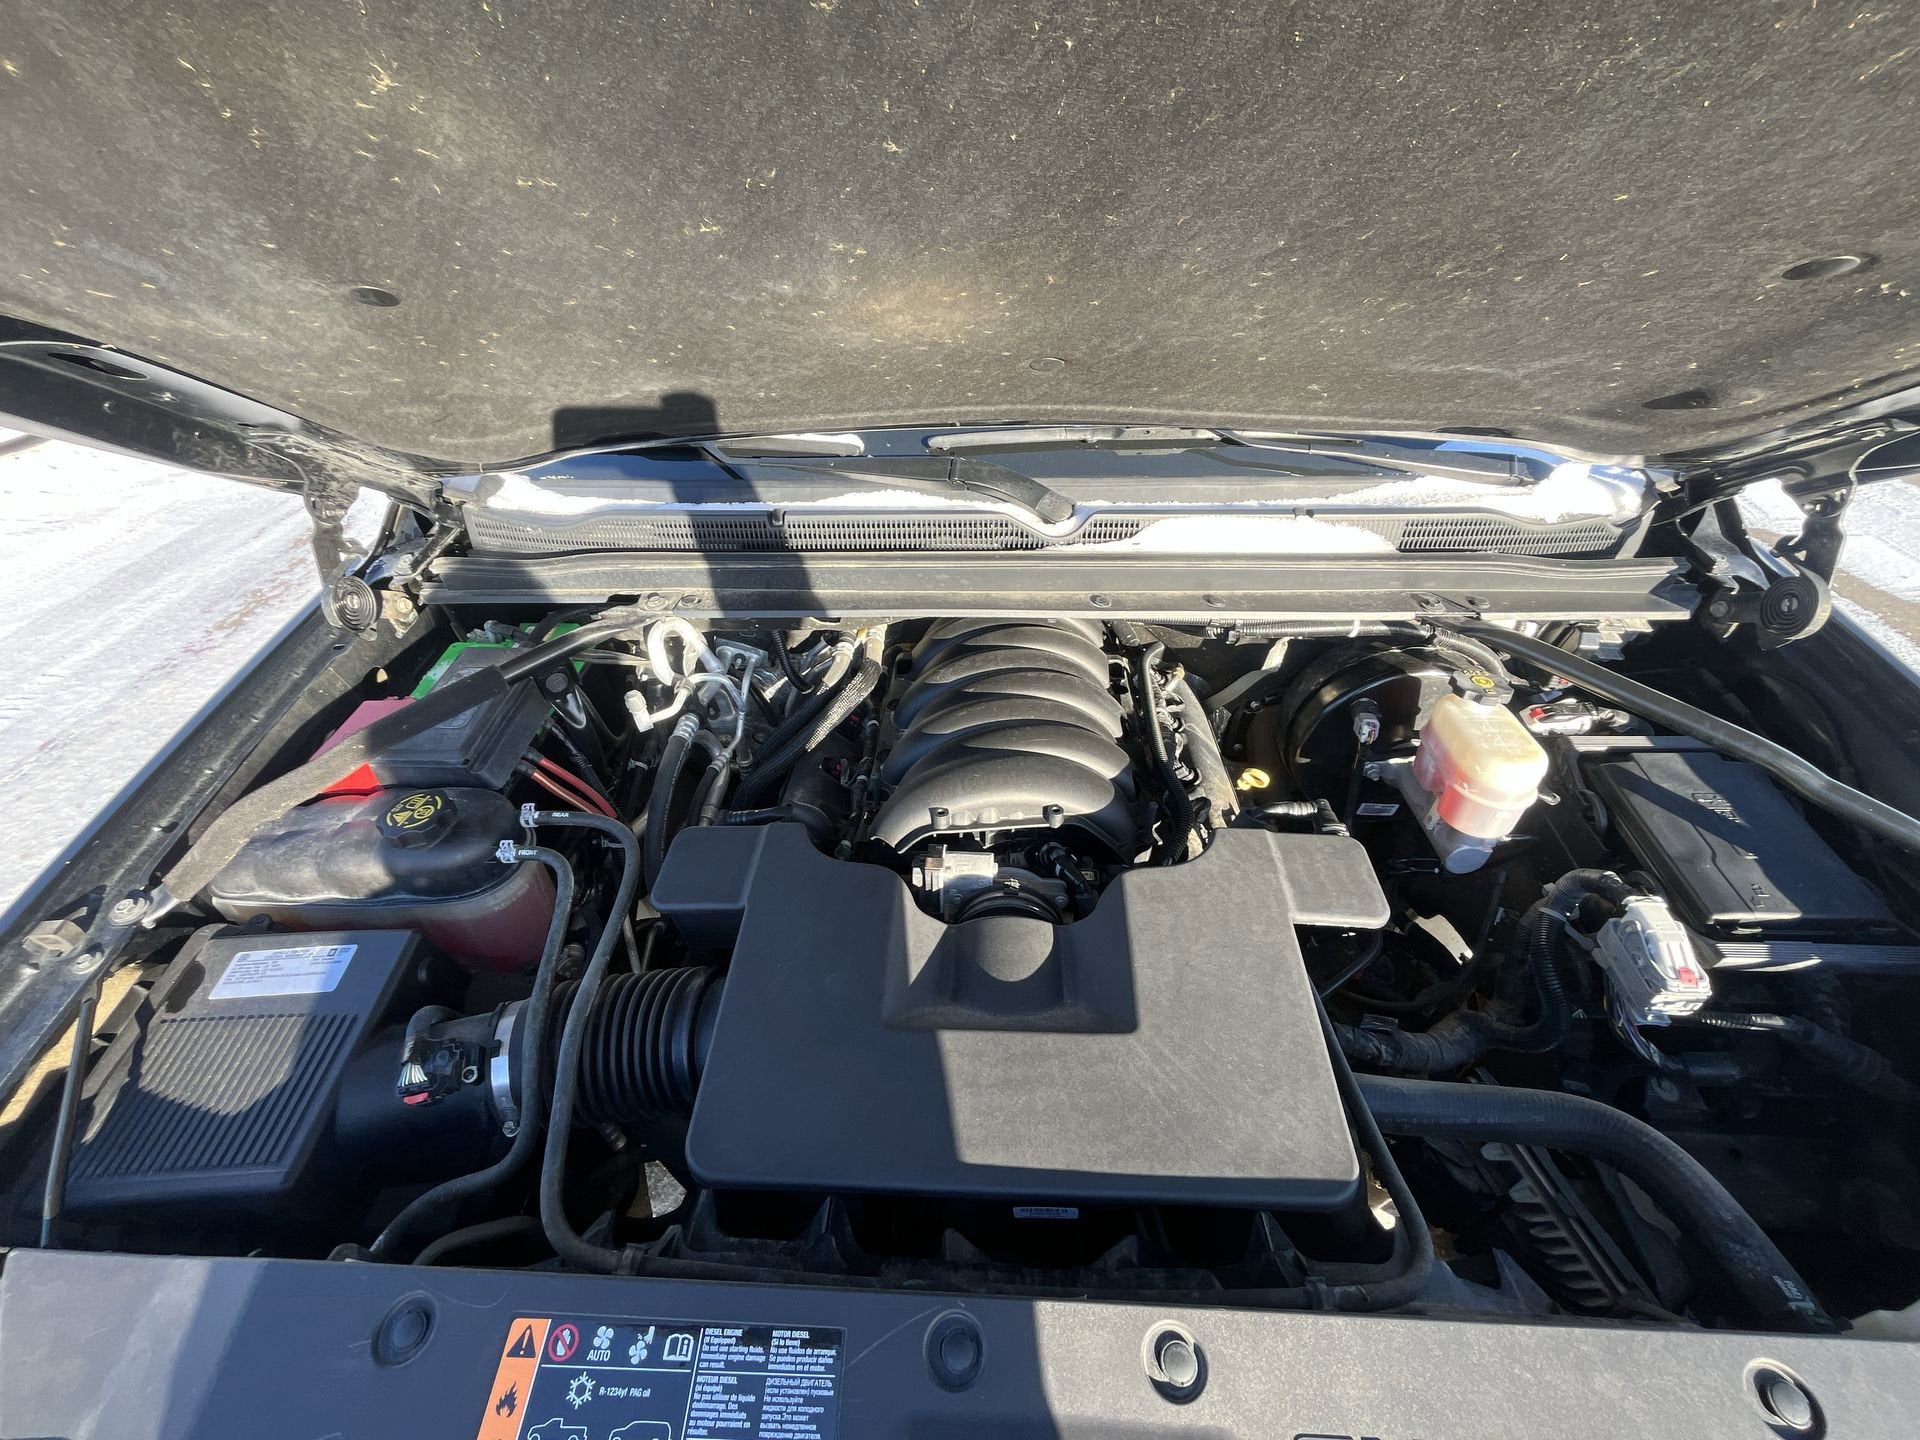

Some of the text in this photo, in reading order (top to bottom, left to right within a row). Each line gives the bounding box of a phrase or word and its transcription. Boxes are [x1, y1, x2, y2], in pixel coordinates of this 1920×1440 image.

[729, 1346, 748, 1354] starting
[587, 1350, 610, 1361] AUTO
[746, 1354, 765, 1362] damage
[777, 1355, 795, 1363] pueden
[796, 1356, 817, 1364] producir
[697, 1375, 737, 1384] MOTEUR DIESEL
[801, 1379, 832, 1387] ДВИГАТЕЛЬ
[630, 1387, 642, 1397] PAG
